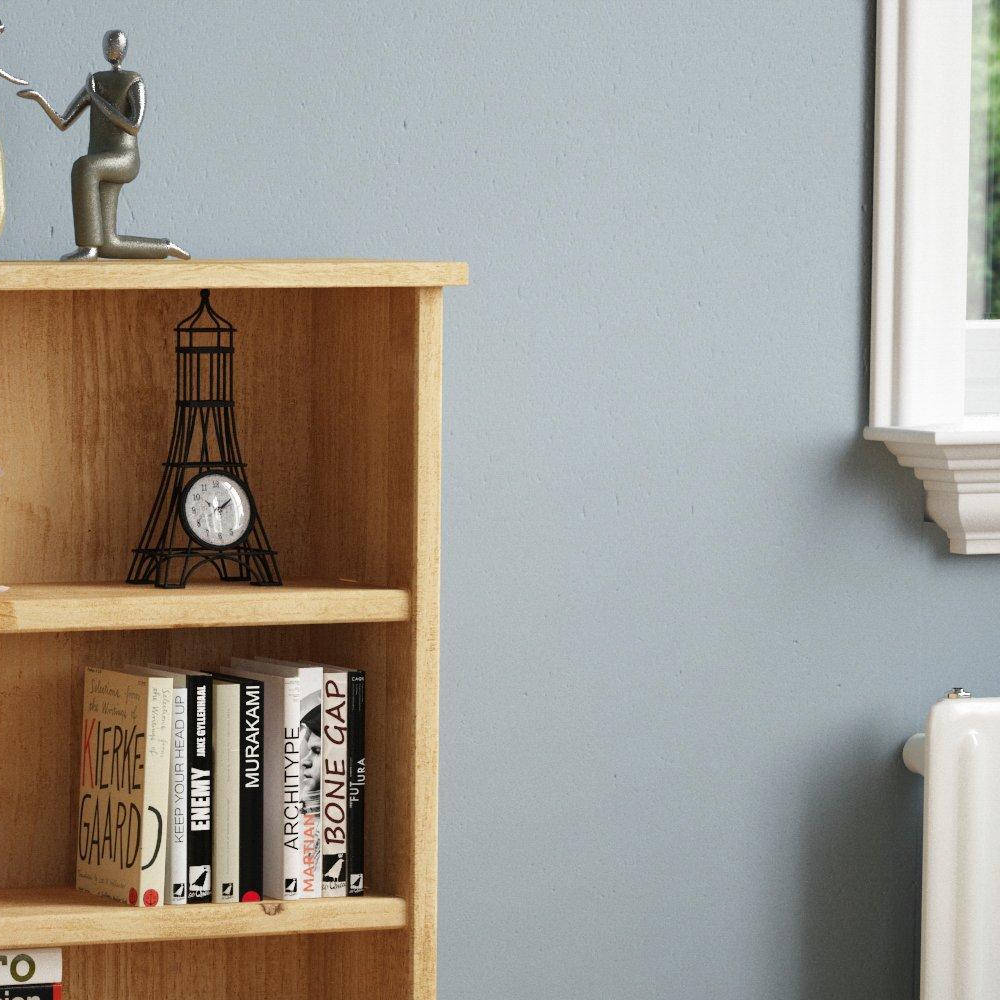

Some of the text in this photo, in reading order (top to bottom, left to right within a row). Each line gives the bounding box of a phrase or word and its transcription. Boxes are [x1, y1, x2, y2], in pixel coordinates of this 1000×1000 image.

[174, 695, 185, 843] KEEP YOUR HEAD UP
[196, 737, 206, 757] JAKE
[245, 685, 260, 788] MURAKAMI
[324, 680, 348, 845] BONE GAP
[79, 793, 142, 870] GAARD
[191, 767, 211, 831] ENEMY
[284, 727, 300, 850] ARCHITYPE
[303, 814, 315, 892] MARTIAN
